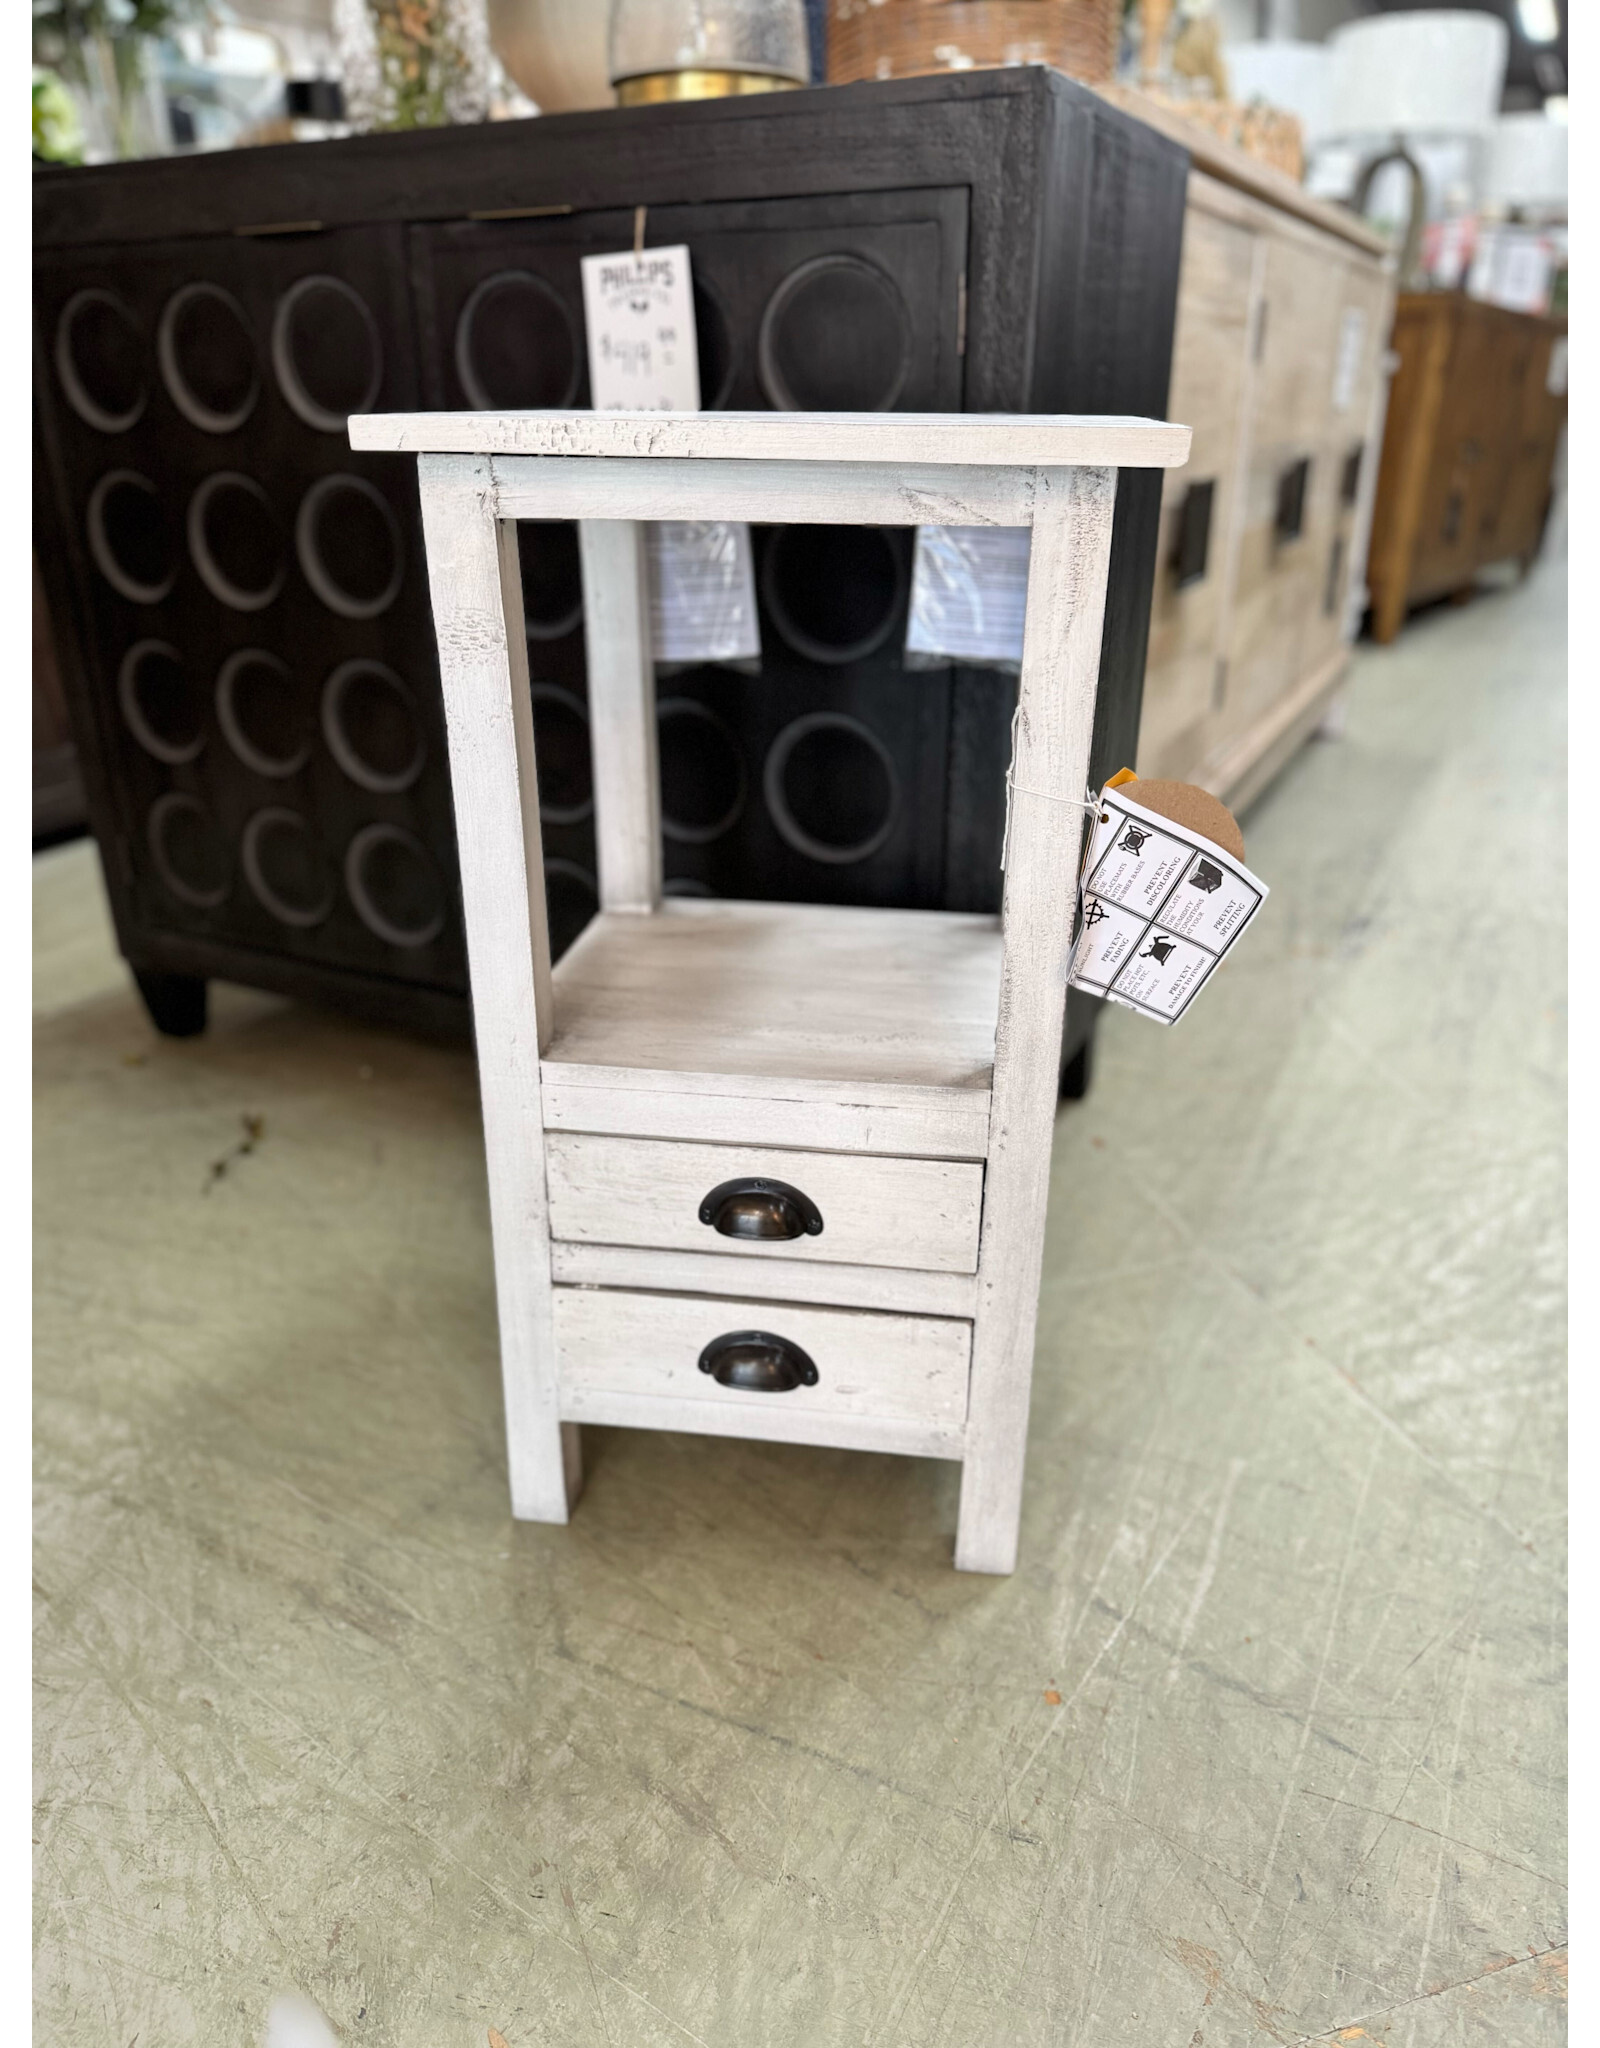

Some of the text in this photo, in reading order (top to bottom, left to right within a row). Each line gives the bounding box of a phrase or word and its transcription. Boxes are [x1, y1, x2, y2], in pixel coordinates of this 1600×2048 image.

[1091, 868, 1106, 889] DO NOT
[1098, 882, 1108, 892] USE
[1104, 863, 1127, 895] PLACEMATS
[1111, 884, 1122, 897] WITH
[1117, 861, 1145, 901] RUBBER BASES
[1144, 861, 1167, 894] PREVENT
[1147, 857, 1180, 906] DISCOLORING
[1160, 895, 1181, 923] REGULATE
[1167, 916, 1176, 926] THE
[1173, 901, 1193, 929] HUMIDITY
[1180, 899, 1204, 932] CONDITIONS
[1192, 912, 1204, 927] YOUR
[1214, 900, 1236, 929] PREVENT
[1220, 903, 1245, 936] SPLITTING
[1101, 931, 1122, 961] PREVENT
[1110, 938, 1129, 962] FADING
[1123, 970, 1132, 981] NOT
[1123, 974, 1138, 991] PLACE
[1134, 965, 1144, 975] HOT
[1169, 965, 1191, 995] PREVENT
[1136, 990, 1143, 998] ON
[1142, 979, 1160, 1001] SURFACE
[1168, 984, 1186, 1009] DAMAGE
[1185, 978, 1192, 986] TO
